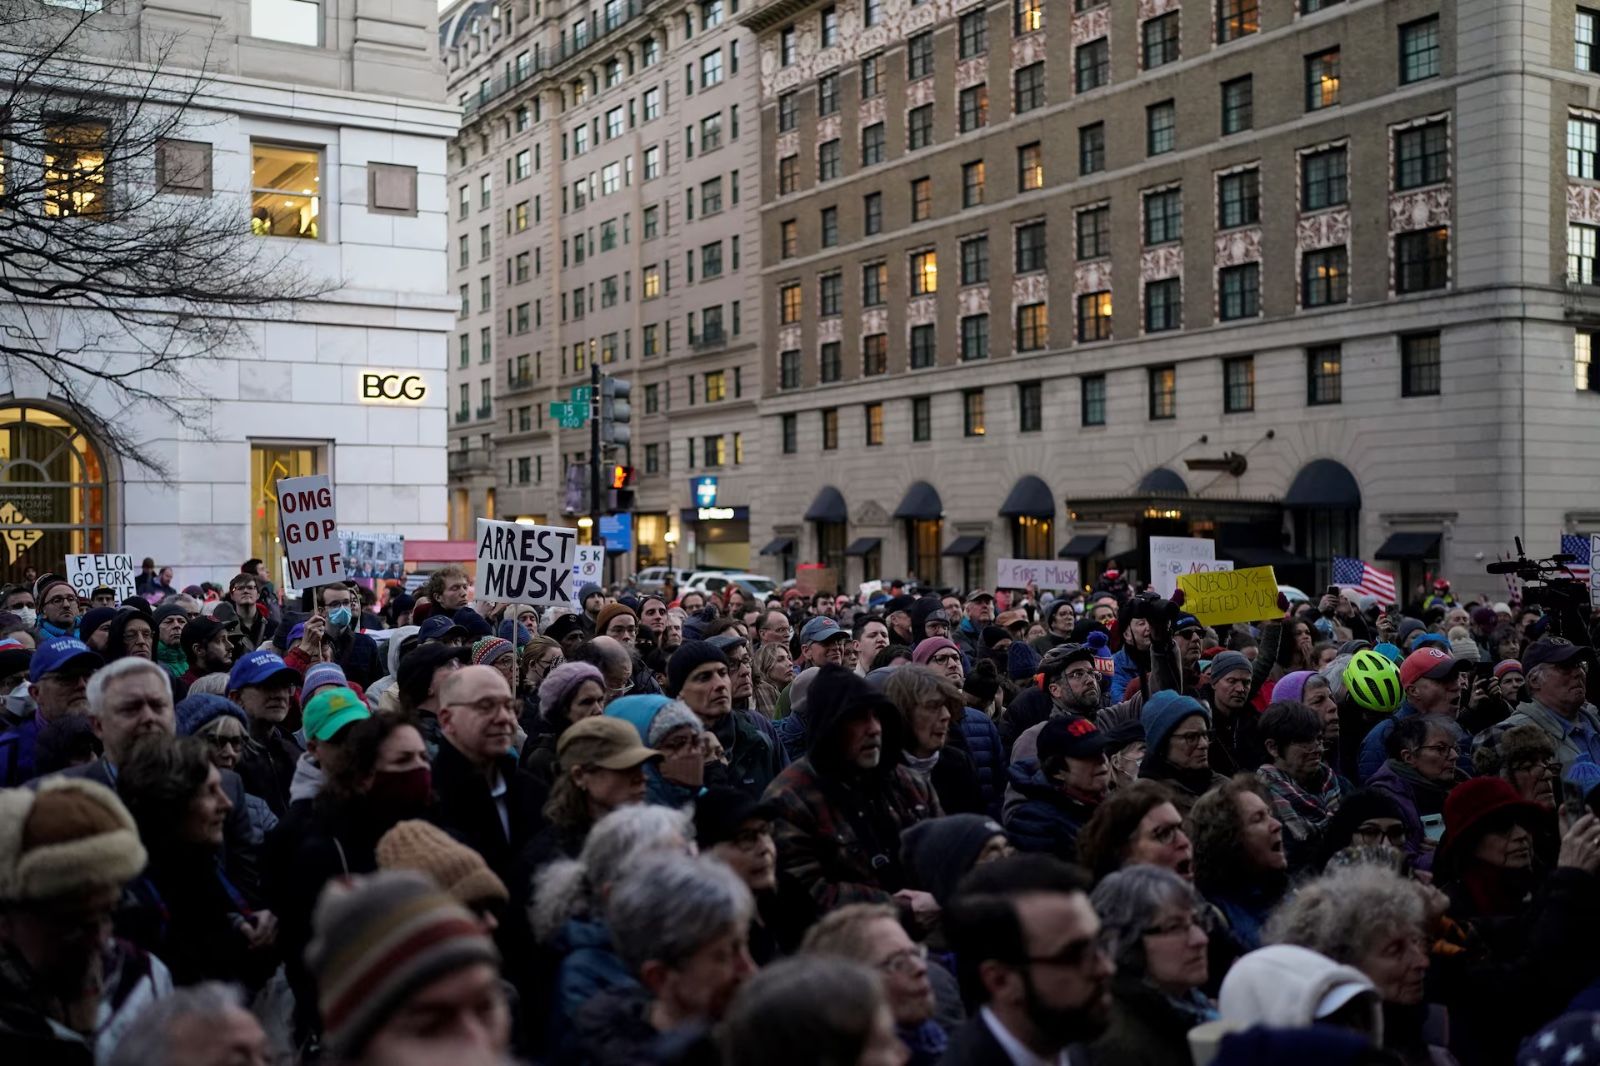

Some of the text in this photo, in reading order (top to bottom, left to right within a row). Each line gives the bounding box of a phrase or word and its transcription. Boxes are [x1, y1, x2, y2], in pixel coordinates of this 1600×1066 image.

[363, 374, 426, 400] BCG
[563, 404, 574, 417] 15
[282, 488, 331, 513] OMG
[286, 519, 335, 544] GOP
[479, 525, 575, 563] ARREST
[77, 555, 133, 571] F ELON
[291, 553, 340, 580] WTF
[1012, 564, 1079, 585] FIRE MUSK
[73, 571, 132, 588] GO FORK
[484, 562, 571, 602] MUSK
[1181, 571, 1253, 594] NOBODY
